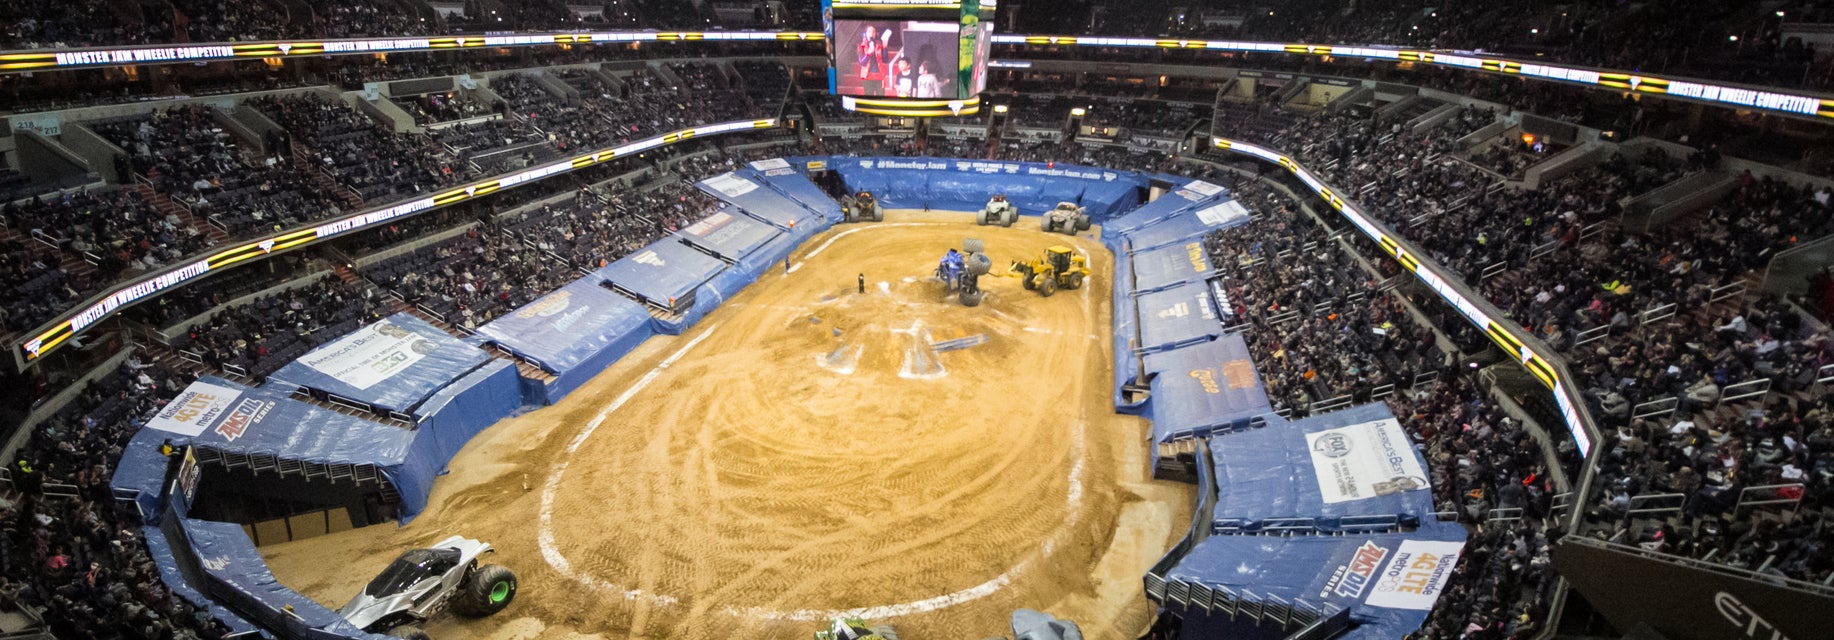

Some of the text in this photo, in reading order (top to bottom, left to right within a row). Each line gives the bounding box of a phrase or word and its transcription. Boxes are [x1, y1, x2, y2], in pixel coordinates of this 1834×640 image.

[56, 51, 109, 65] MONSTER
[111, 50, 132, 63] JAM
[133, 48, 176, 61] WHEELIE
[70, 260, 210, 333] MONSTER JAM WHEELIE COMPETITION
[159, 390, 198, 420] Nationwide
[174, 393, 216, 422] 4G LTE
[217, 398, 263, 439] AMSOIL
[253, 400, 276, 424] SERIES
[1329, 436, 1347, 453] FOX
[1320, 565, 1347, 598] SERIES
[1338, 544, 1387, 597] AMSOIL
[1398, 552, 1438, 595] 4G LTE
[1422, 553, 1456, 596] Nationwide
